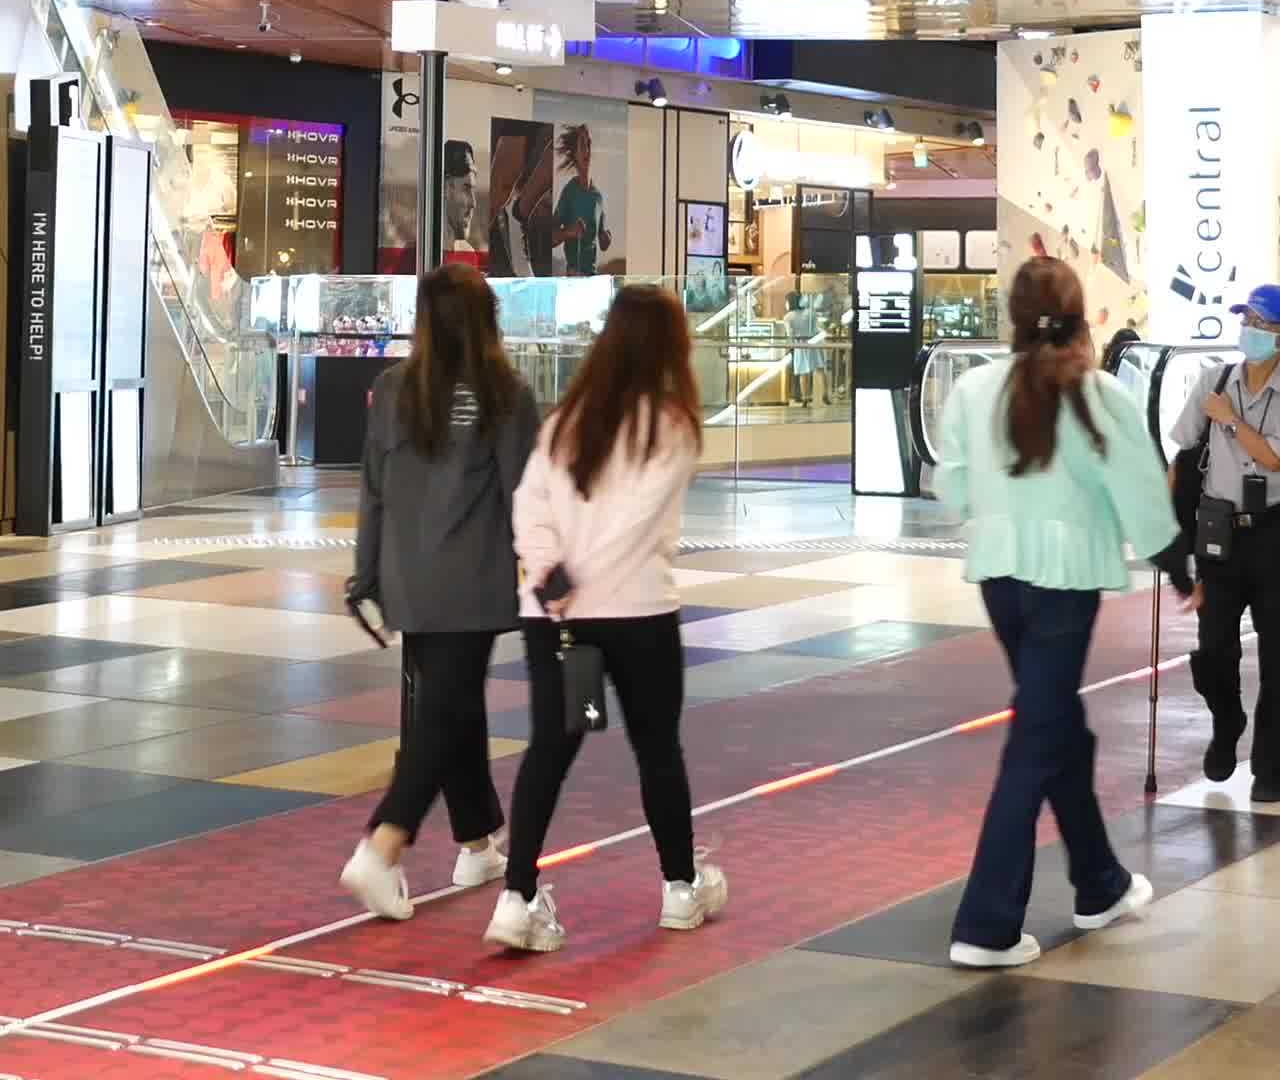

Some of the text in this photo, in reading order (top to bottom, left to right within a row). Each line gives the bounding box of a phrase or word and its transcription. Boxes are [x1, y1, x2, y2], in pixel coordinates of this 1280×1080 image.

[1188, 107, 1223, 273] central
[28, 212, 47, 361] I'M HERE TO HELP!
